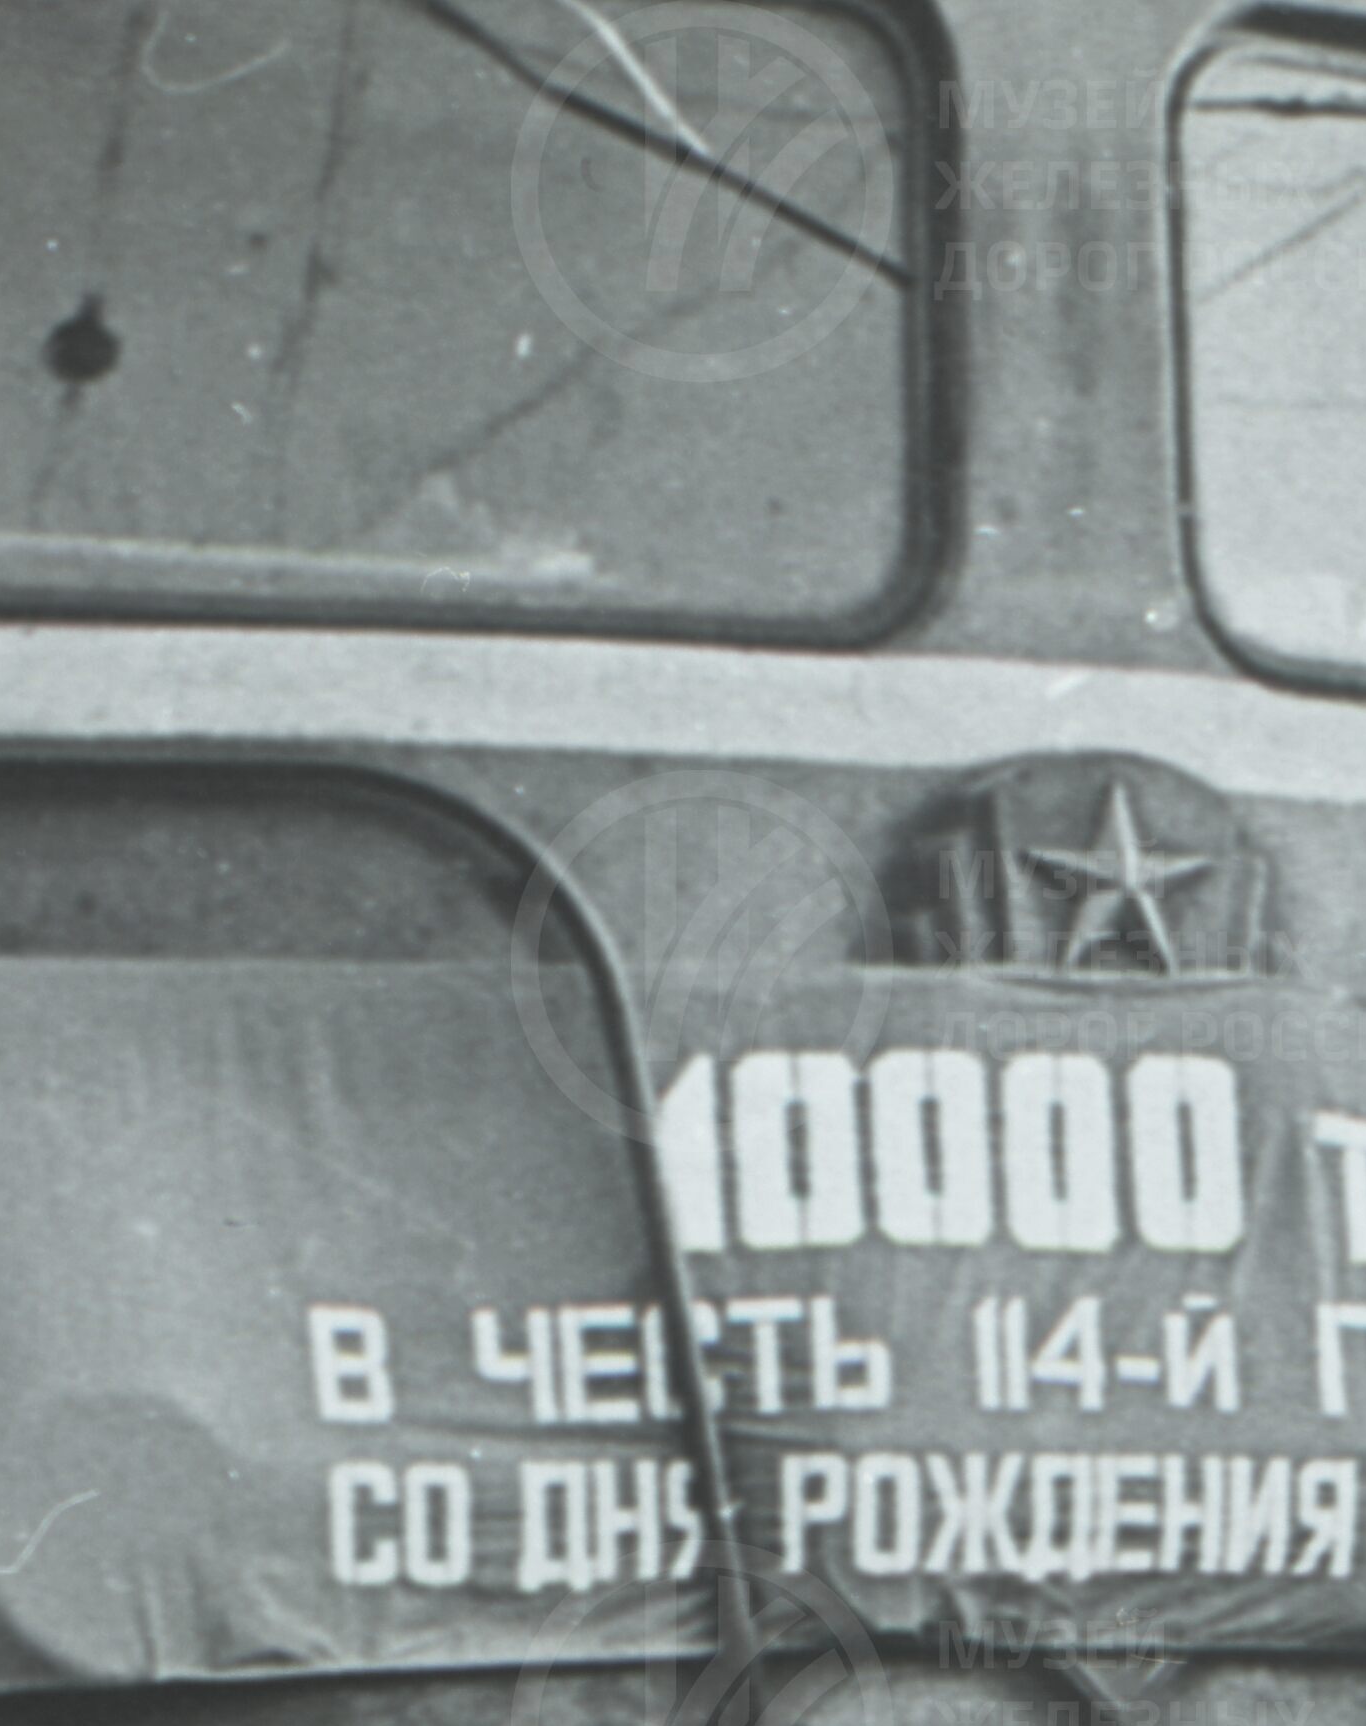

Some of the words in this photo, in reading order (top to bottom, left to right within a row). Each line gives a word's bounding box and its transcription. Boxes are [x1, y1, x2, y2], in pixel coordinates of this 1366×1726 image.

[654, 1049, 1244, 1253] 10000
[309, 1305, 394, 1422] В
[472, 1297, 892, 1422] ЧЕСТЬ
[974, 1294, 1239, 1413] 114-Й
[331, 1461, 472, 1586] СО
[782, 1452, 1359, 1582] РОЖДЕНИЯ
